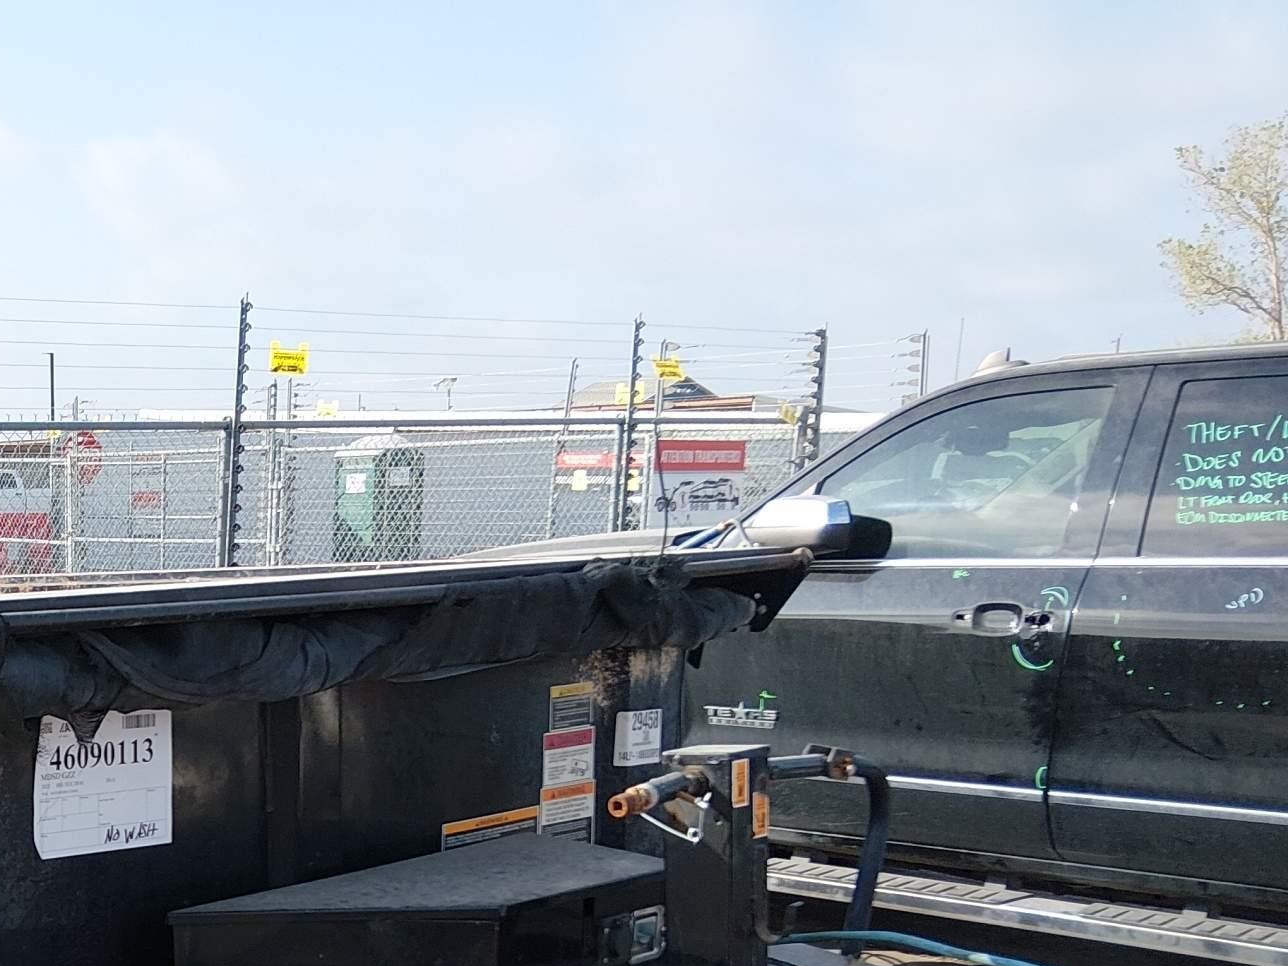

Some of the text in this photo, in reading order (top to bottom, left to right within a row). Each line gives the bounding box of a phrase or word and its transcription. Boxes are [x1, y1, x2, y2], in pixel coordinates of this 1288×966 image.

[1226, 475, 1247, 488] TO
[1249, 471, 1288, 489] STEE
[49, 738, 154, 771] 46090113
[104, 825, 121, 844] NO
